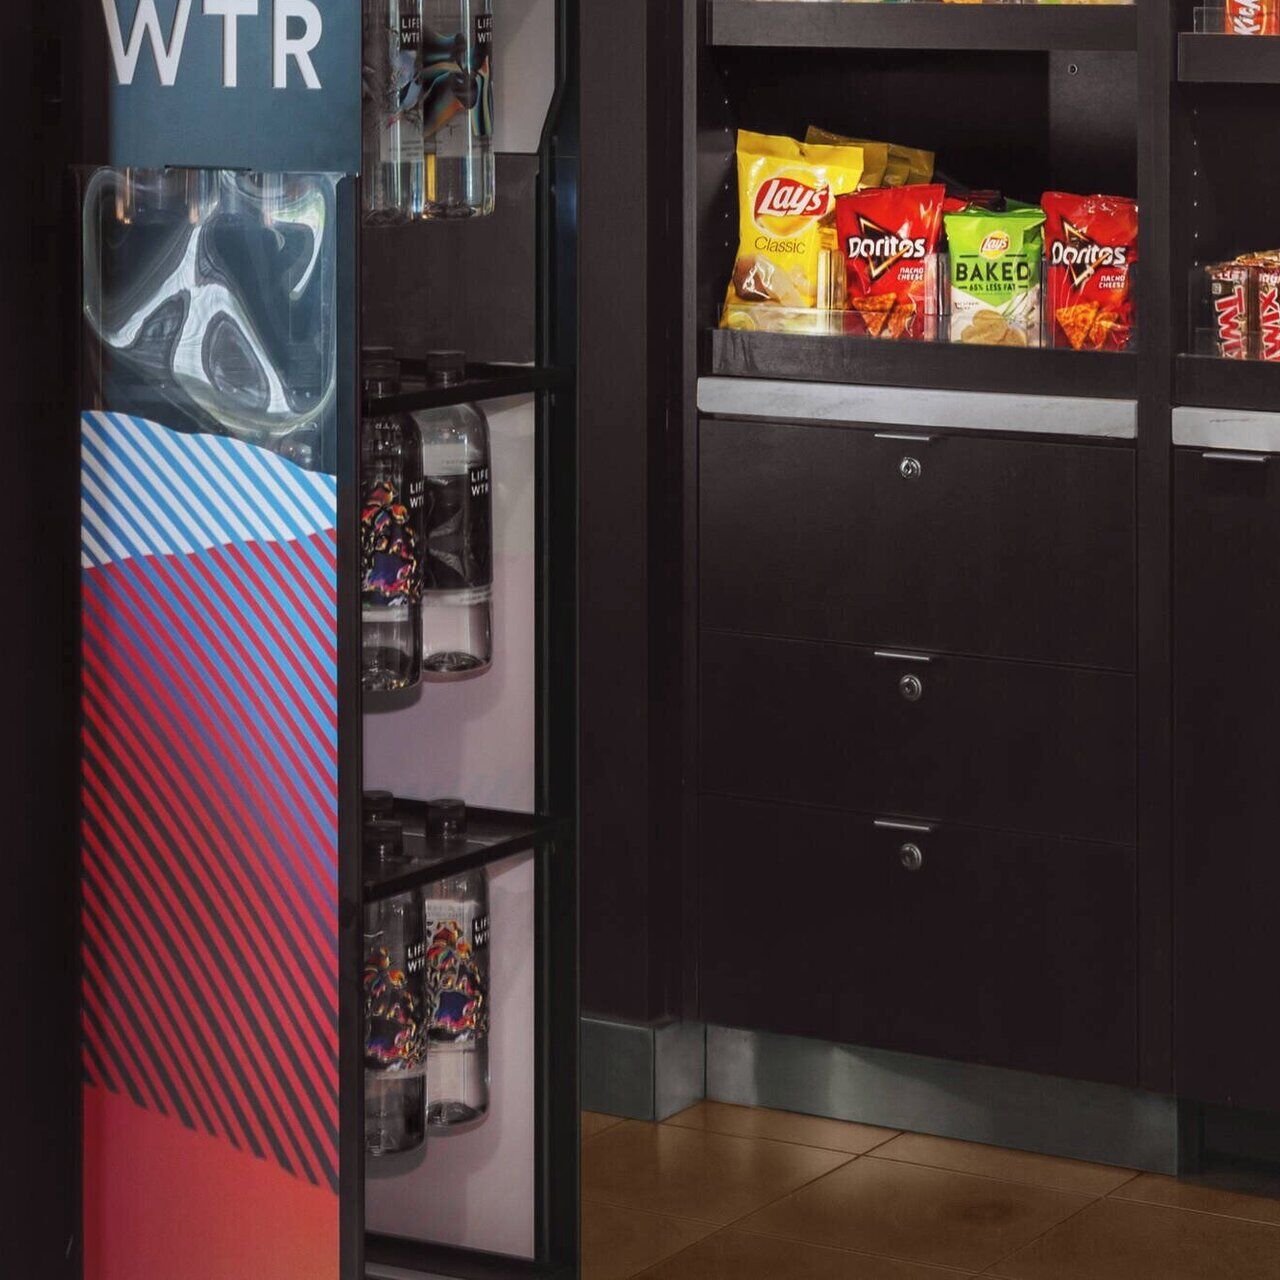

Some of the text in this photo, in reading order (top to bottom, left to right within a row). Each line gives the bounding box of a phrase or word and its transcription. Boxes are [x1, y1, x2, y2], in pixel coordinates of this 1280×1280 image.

[758, 179, 827, 216] Lay's
[755, 236, 805, 254] Classic
[849, 236, 926, 258] Doritos
[1052, 242, 1126, 265] Doritos
[956, 262, 1031, 282] BAKED
